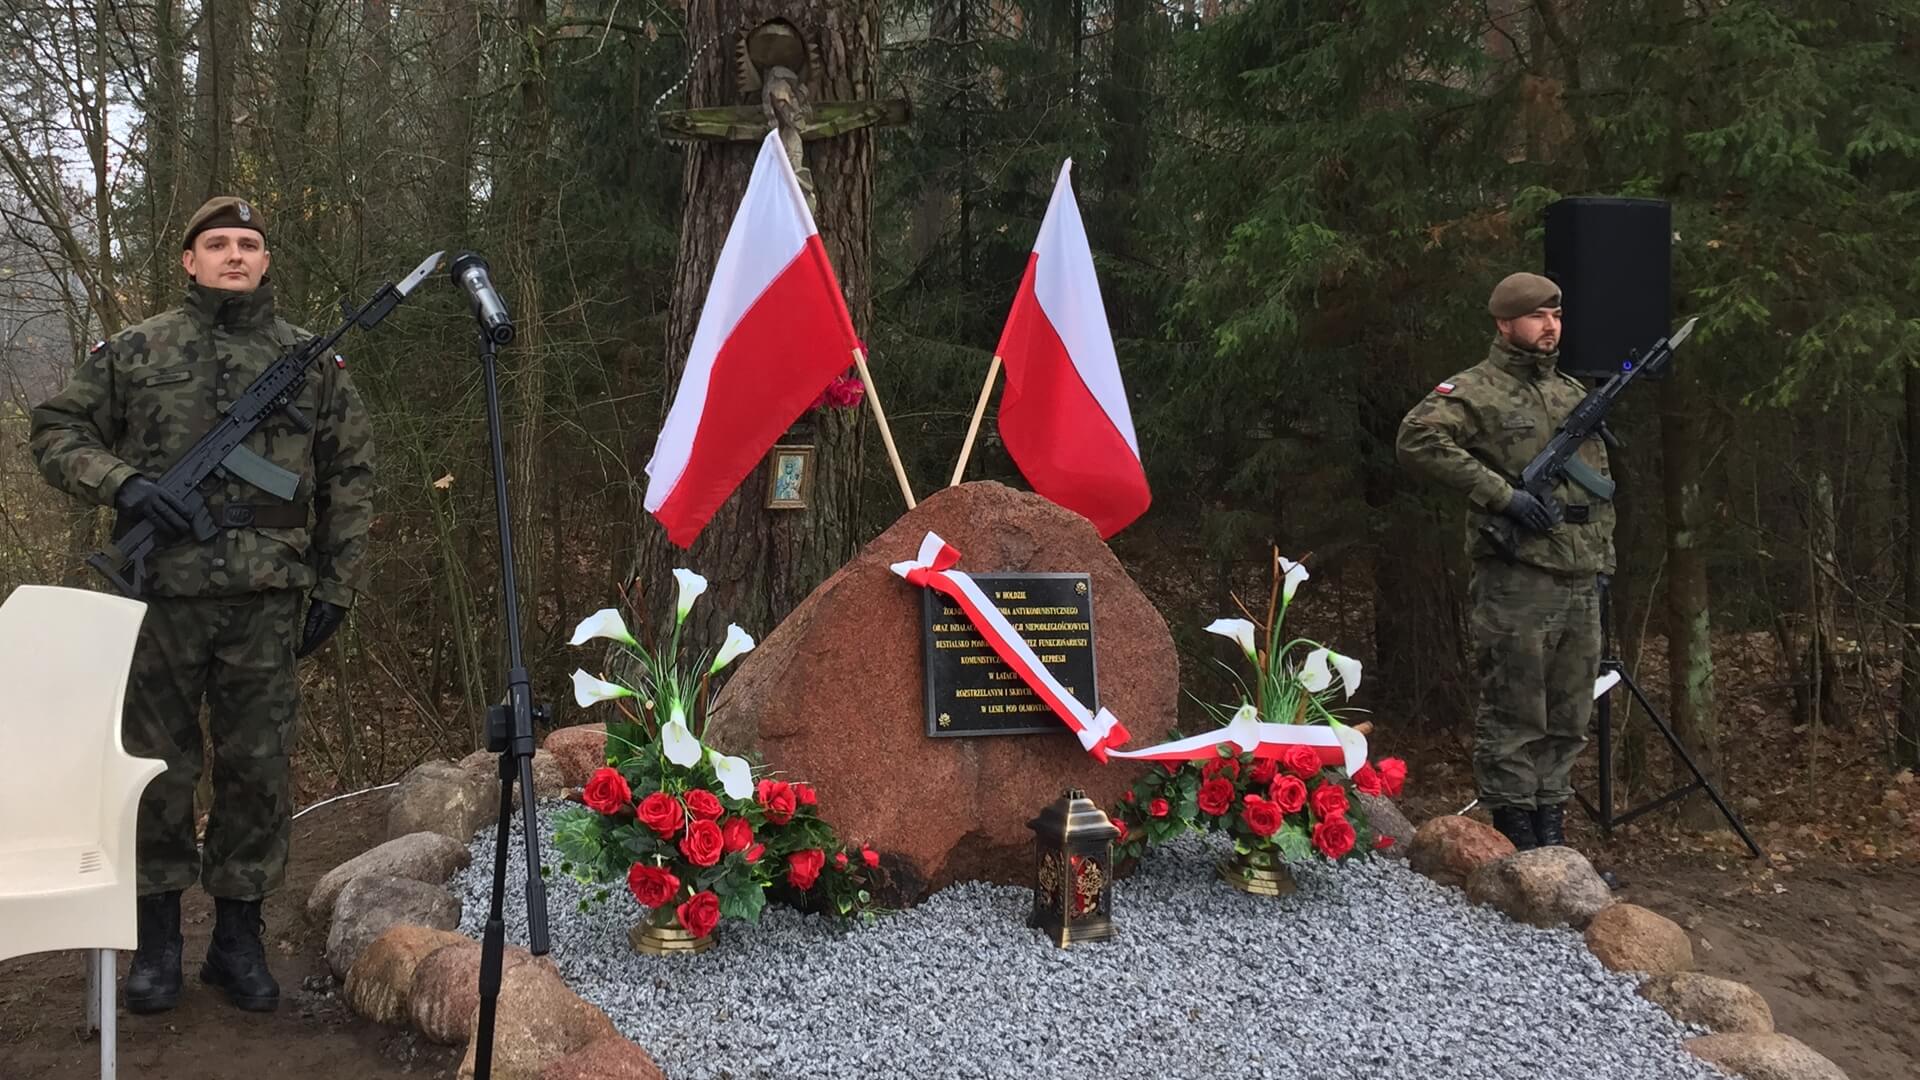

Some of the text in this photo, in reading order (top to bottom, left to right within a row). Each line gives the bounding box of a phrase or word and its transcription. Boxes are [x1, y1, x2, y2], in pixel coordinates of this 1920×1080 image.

[995, 591, 1027, 600] W HOŁDZIE
[1012, 606, 1079, 616] ANTYKOMUNISTYCZNEGO
[932, 623, 948, 632] ORAZ
[935, 640, 970, 649] BESTIALSKO
[1038, 638, 1088, 647] FUNKCJONARIUSZY
[1041, 654, 1067, 664] REPRESJI
[988, 671, 1018, 680] W LATACH
[955, 687, 1004, 698] ROZSTRZELANYM
[980, 705, 987, 713] W
[988, 704, 1004, 713] LESIE
[1006, 704, 1018, 713] POD
